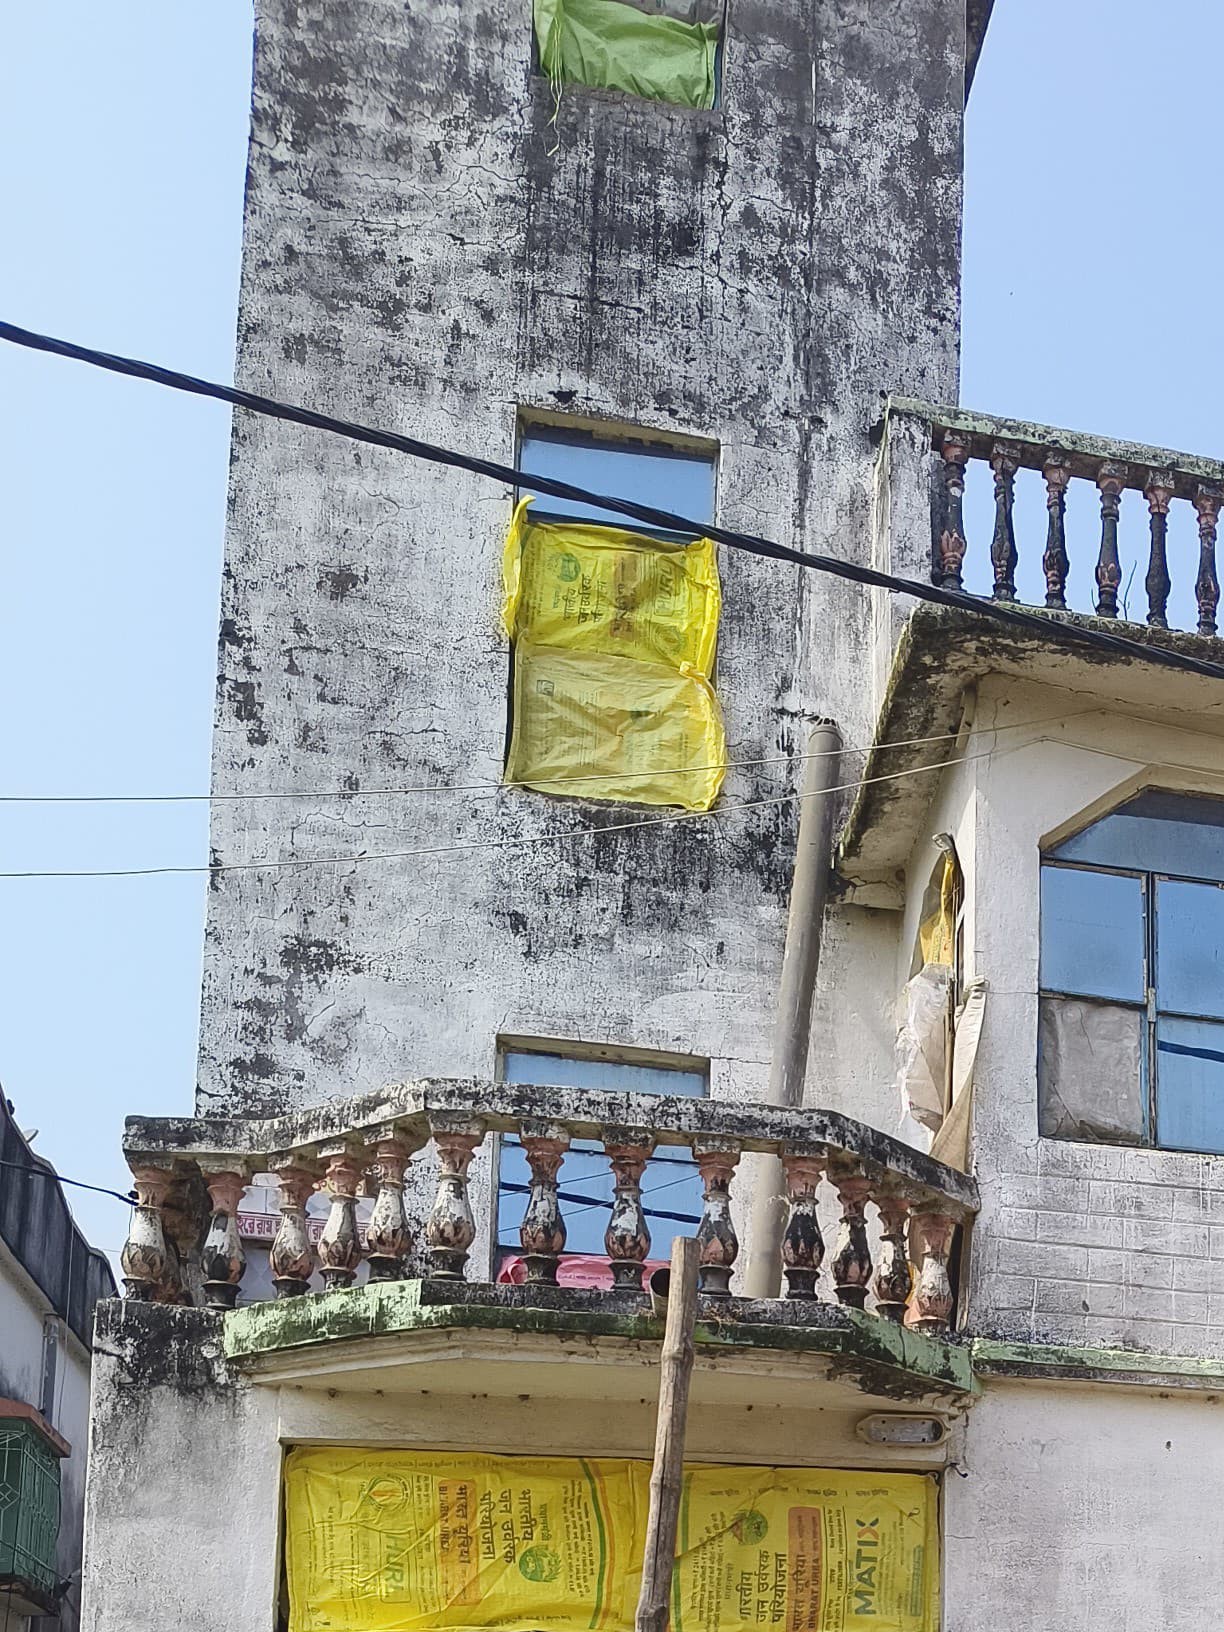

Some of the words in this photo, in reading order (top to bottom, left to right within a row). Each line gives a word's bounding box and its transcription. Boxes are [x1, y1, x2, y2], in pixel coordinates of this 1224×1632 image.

[498, 1489, 513, 1514] जन
[519, 1489, 537, 1541] भारतीय
[479, 1490, 497, 1560] परियोजना
[501, 1519, 520, 1564] उर्वरक
[754, 1549, 771, 1593] उर्वरक
[769, 1551, 787, 1624] परियोजना
[854, 1517, 880, 1616] MATIX
[755, 1598, 769, 1624] जन
[807, 1590, 820, 1629] BHARAT
